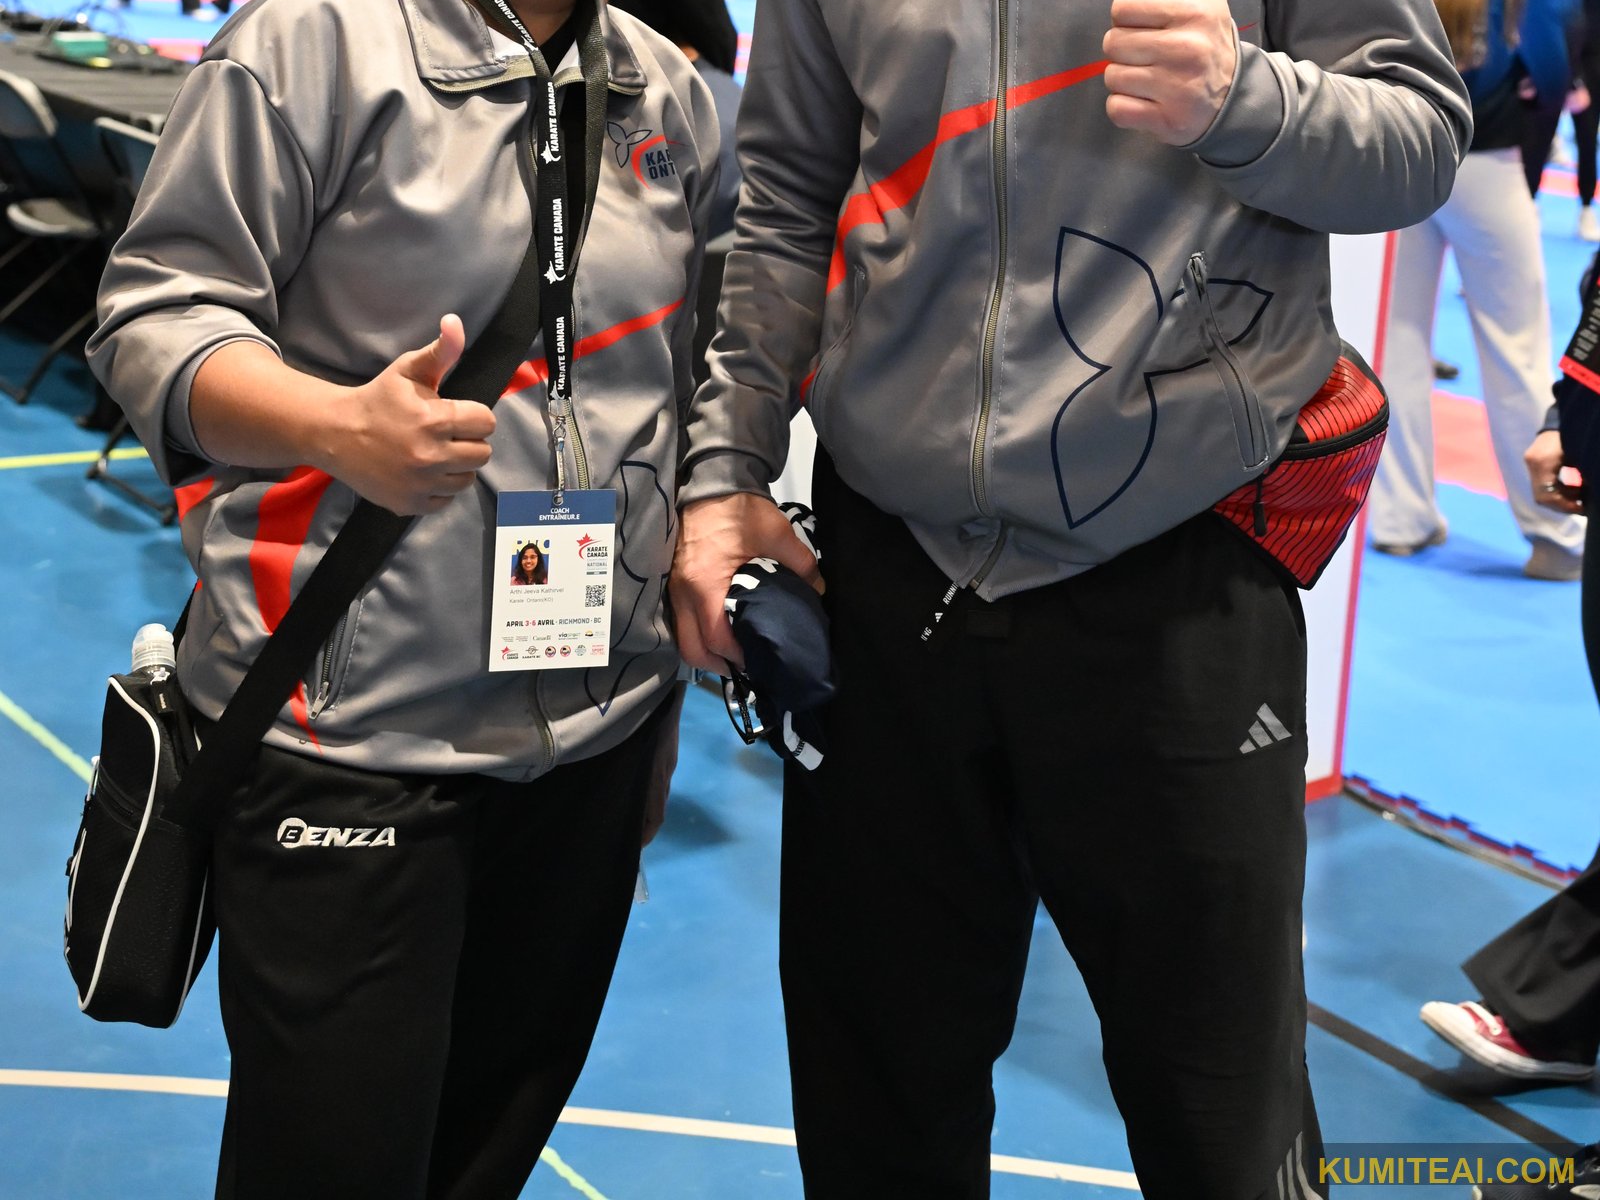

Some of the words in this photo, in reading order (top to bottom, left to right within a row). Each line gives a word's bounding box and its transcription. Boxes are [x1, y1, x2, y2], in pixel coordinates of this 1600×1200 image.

[511, 18, 535, 43] KARATE
[547, 82, 555, 117] CANADA
[549, 119, 560, 152] KARATE
[553, 198, 562, 234] CANADA
[554, 235, 565, 271] KARATE
[556, 316, 565, 354] CANADA
[557, 355, 567, 390] KARATE
[277, 817, 396, 849] BENZA
